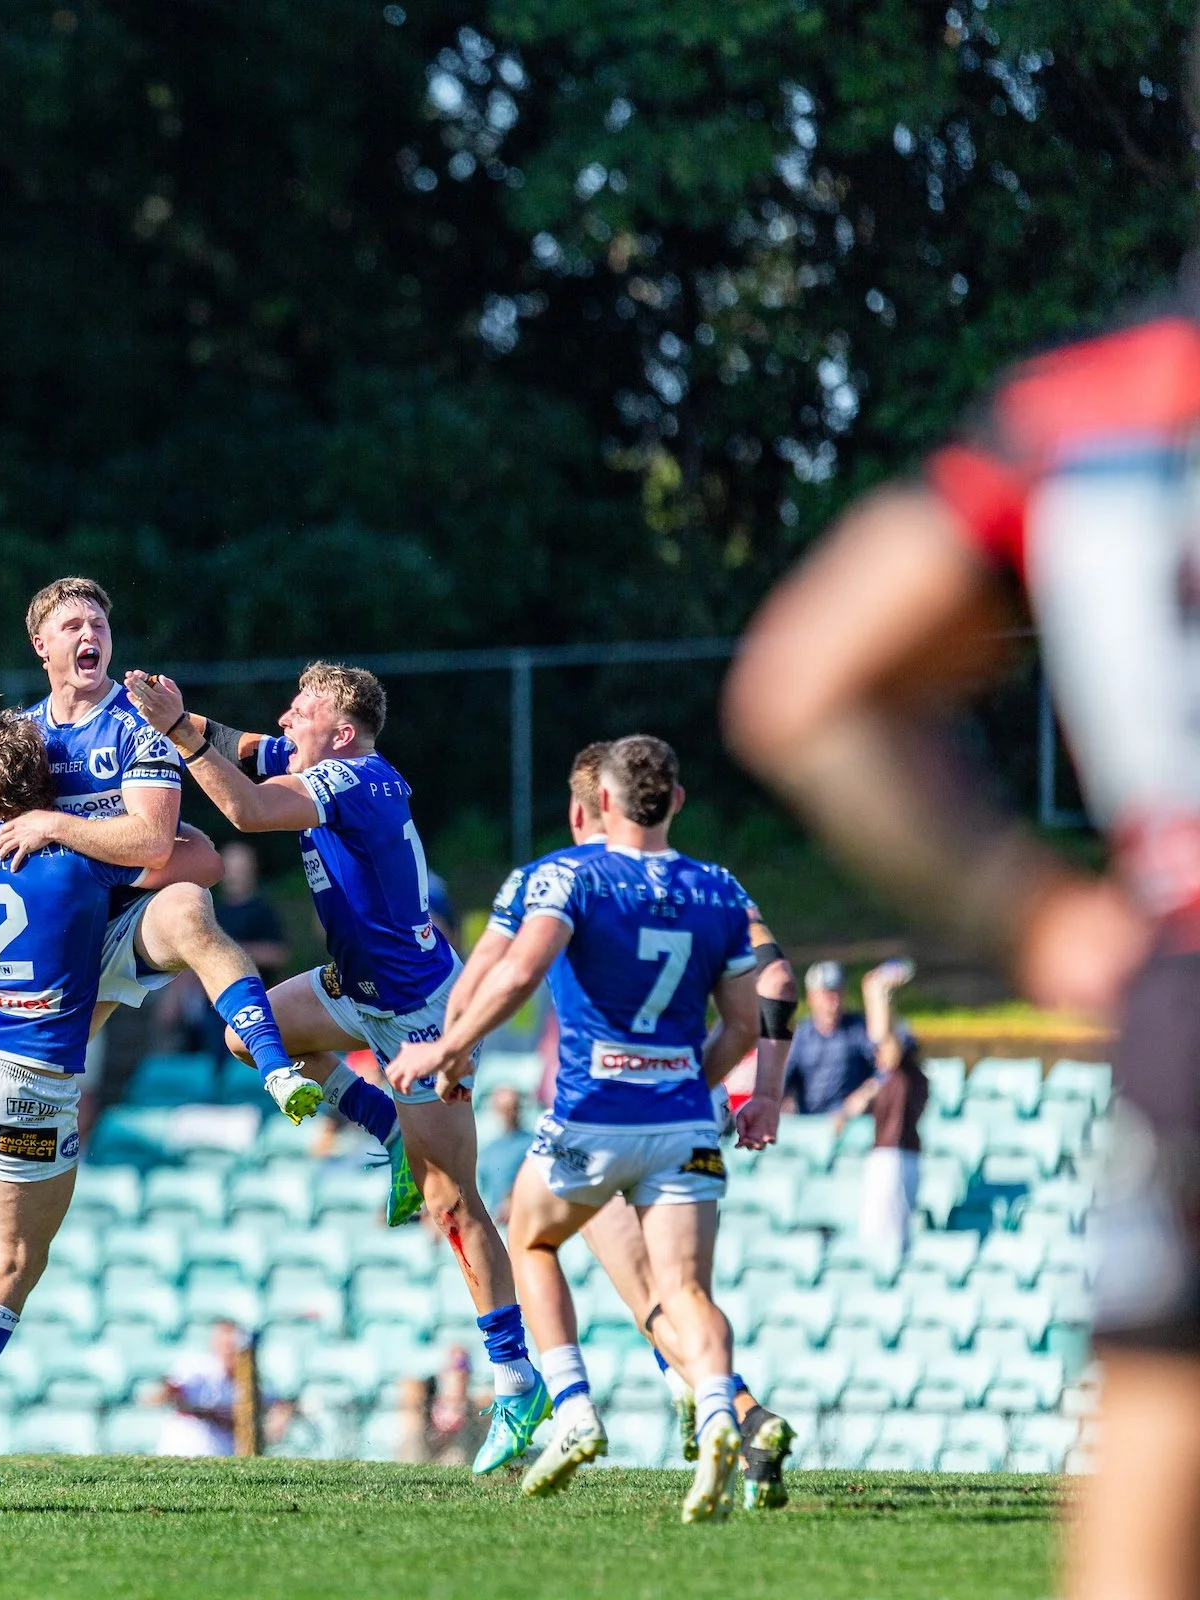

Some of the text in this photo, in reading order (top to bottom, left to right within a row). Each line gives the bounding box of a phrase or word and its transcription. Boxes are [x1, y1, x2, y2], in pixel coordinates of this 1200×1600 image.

[49, 761, 83, 773] USFLEET
[95, 752, 114, 773] N
[403, 819, 429, 912] 1
[631, 927, 693, 1034] 7
[602, 1054, 693, 1071] aramex
[10, 1101, 35, 1114] THE
[0, 1136, 55, 1147] KNOCK-ON
